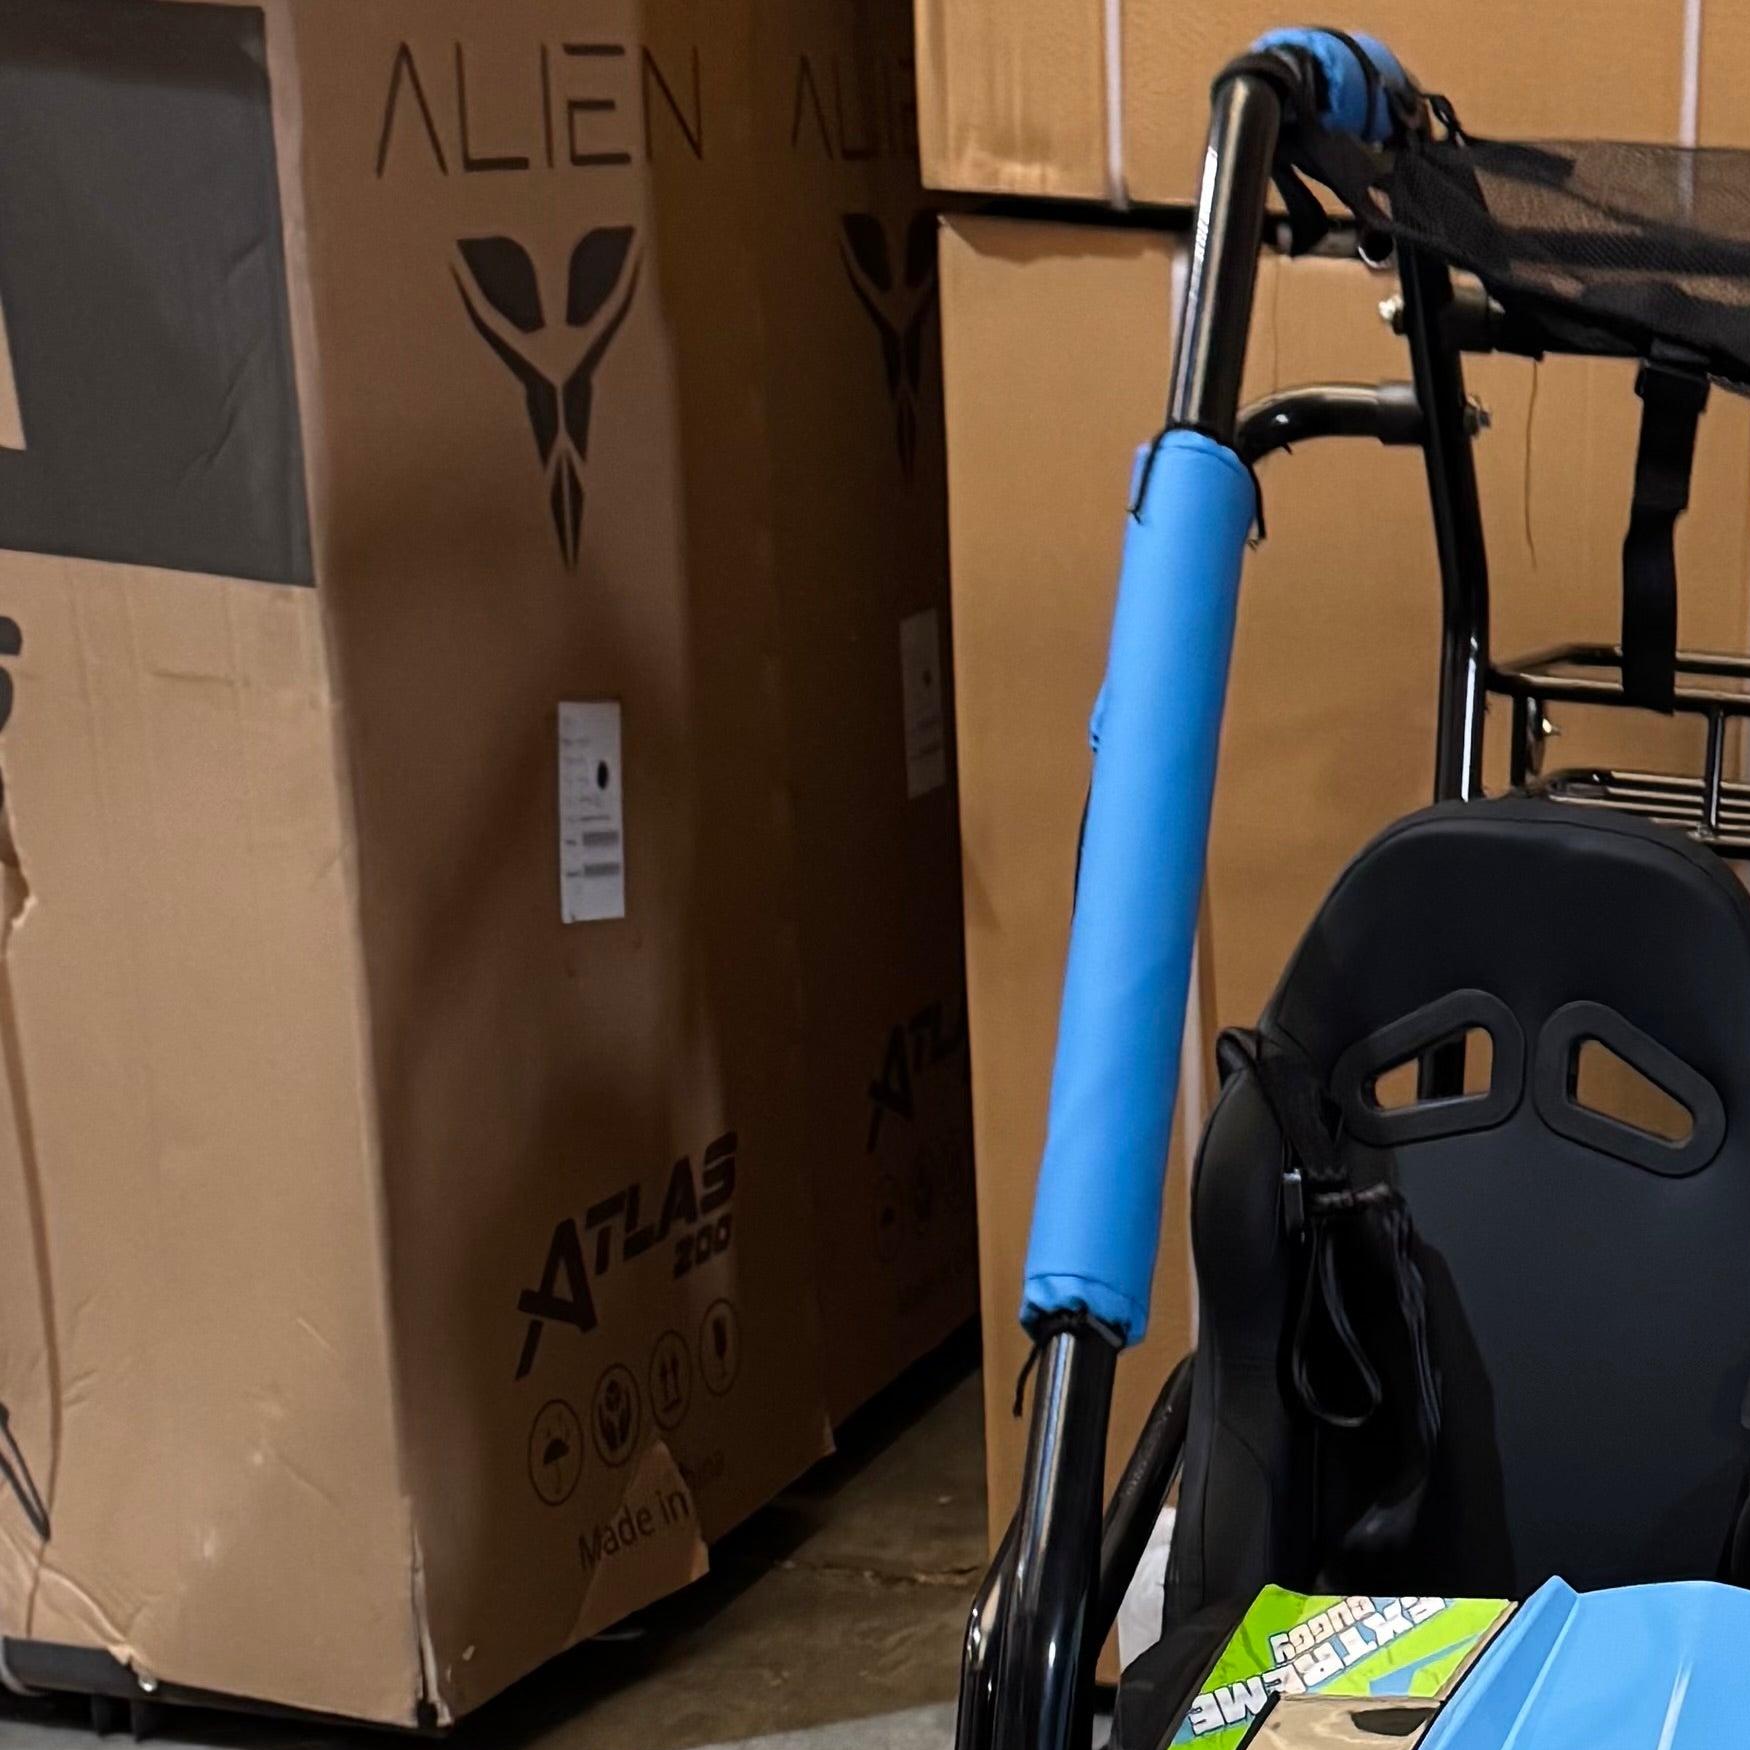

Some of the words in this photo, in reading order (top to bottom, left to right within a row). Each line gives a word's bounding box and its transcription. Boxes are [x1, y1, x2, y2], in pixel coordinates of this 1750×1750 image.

[375, 42, 704, 179] ALIEN
[791, 53, 916, 163] ALI
[866, 1000, 966, 1156] ATL
[514, 1131, 738, 1382] ATLAS
[672, 1212, 733, 1281] 200
[577, 1502, 656, 1572] Made
[661, 1488, 691, 1527] in
[1187, 1596, 1446, 1736] EXTREME
